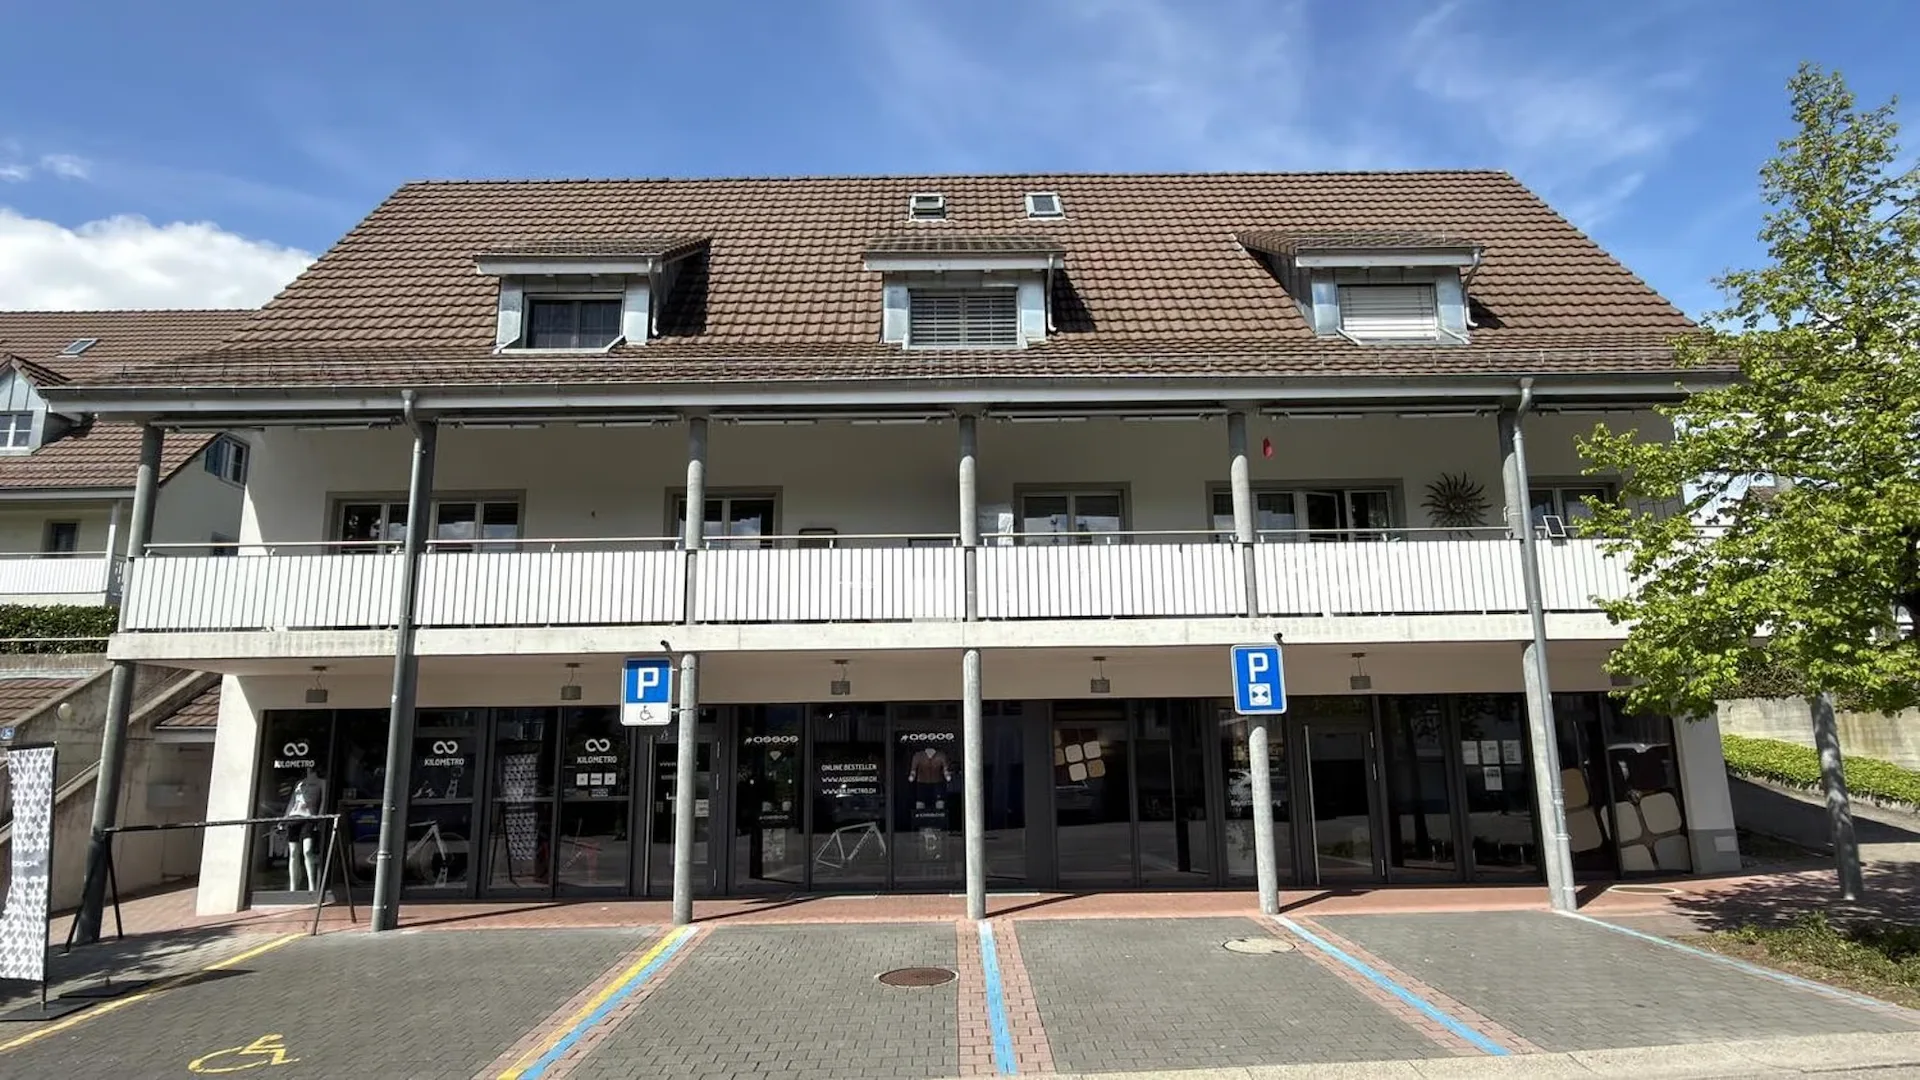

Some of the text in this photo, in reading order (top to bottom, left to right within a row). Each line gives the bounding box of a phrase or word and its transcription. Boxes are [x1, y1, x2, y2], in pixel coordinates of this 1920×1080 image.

[1248, 652, 1269, 683] P
[637, 667, 660, 700] P
[424, 758, 464, 766] KILOMETRO
[576, 756, 617, 764] KILOMETRO
